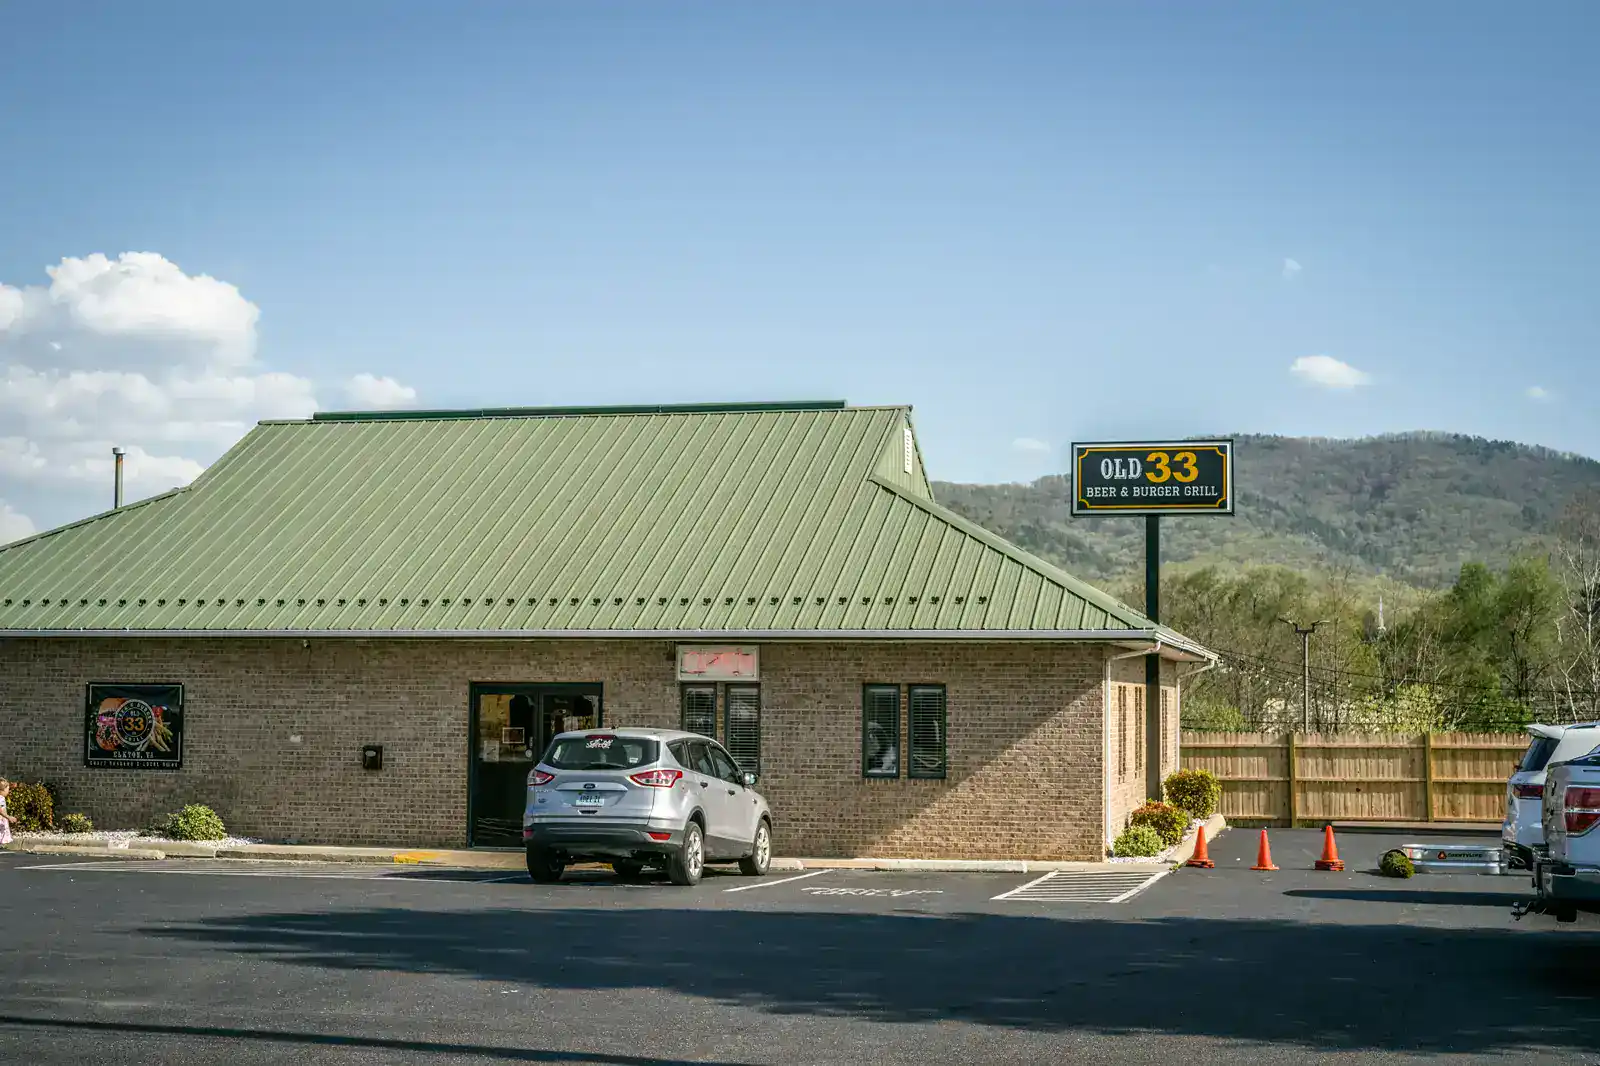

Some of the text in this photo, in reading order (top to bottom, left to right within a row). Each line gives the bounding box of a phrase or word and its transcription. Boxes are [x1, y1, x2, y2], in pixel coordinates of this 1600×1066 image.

[1101, 452, 1199, 483] OLD 33
[1086, 485, 1218, 497] BEER & BURGER GRILL
[123, 717, 145, 731] 33
